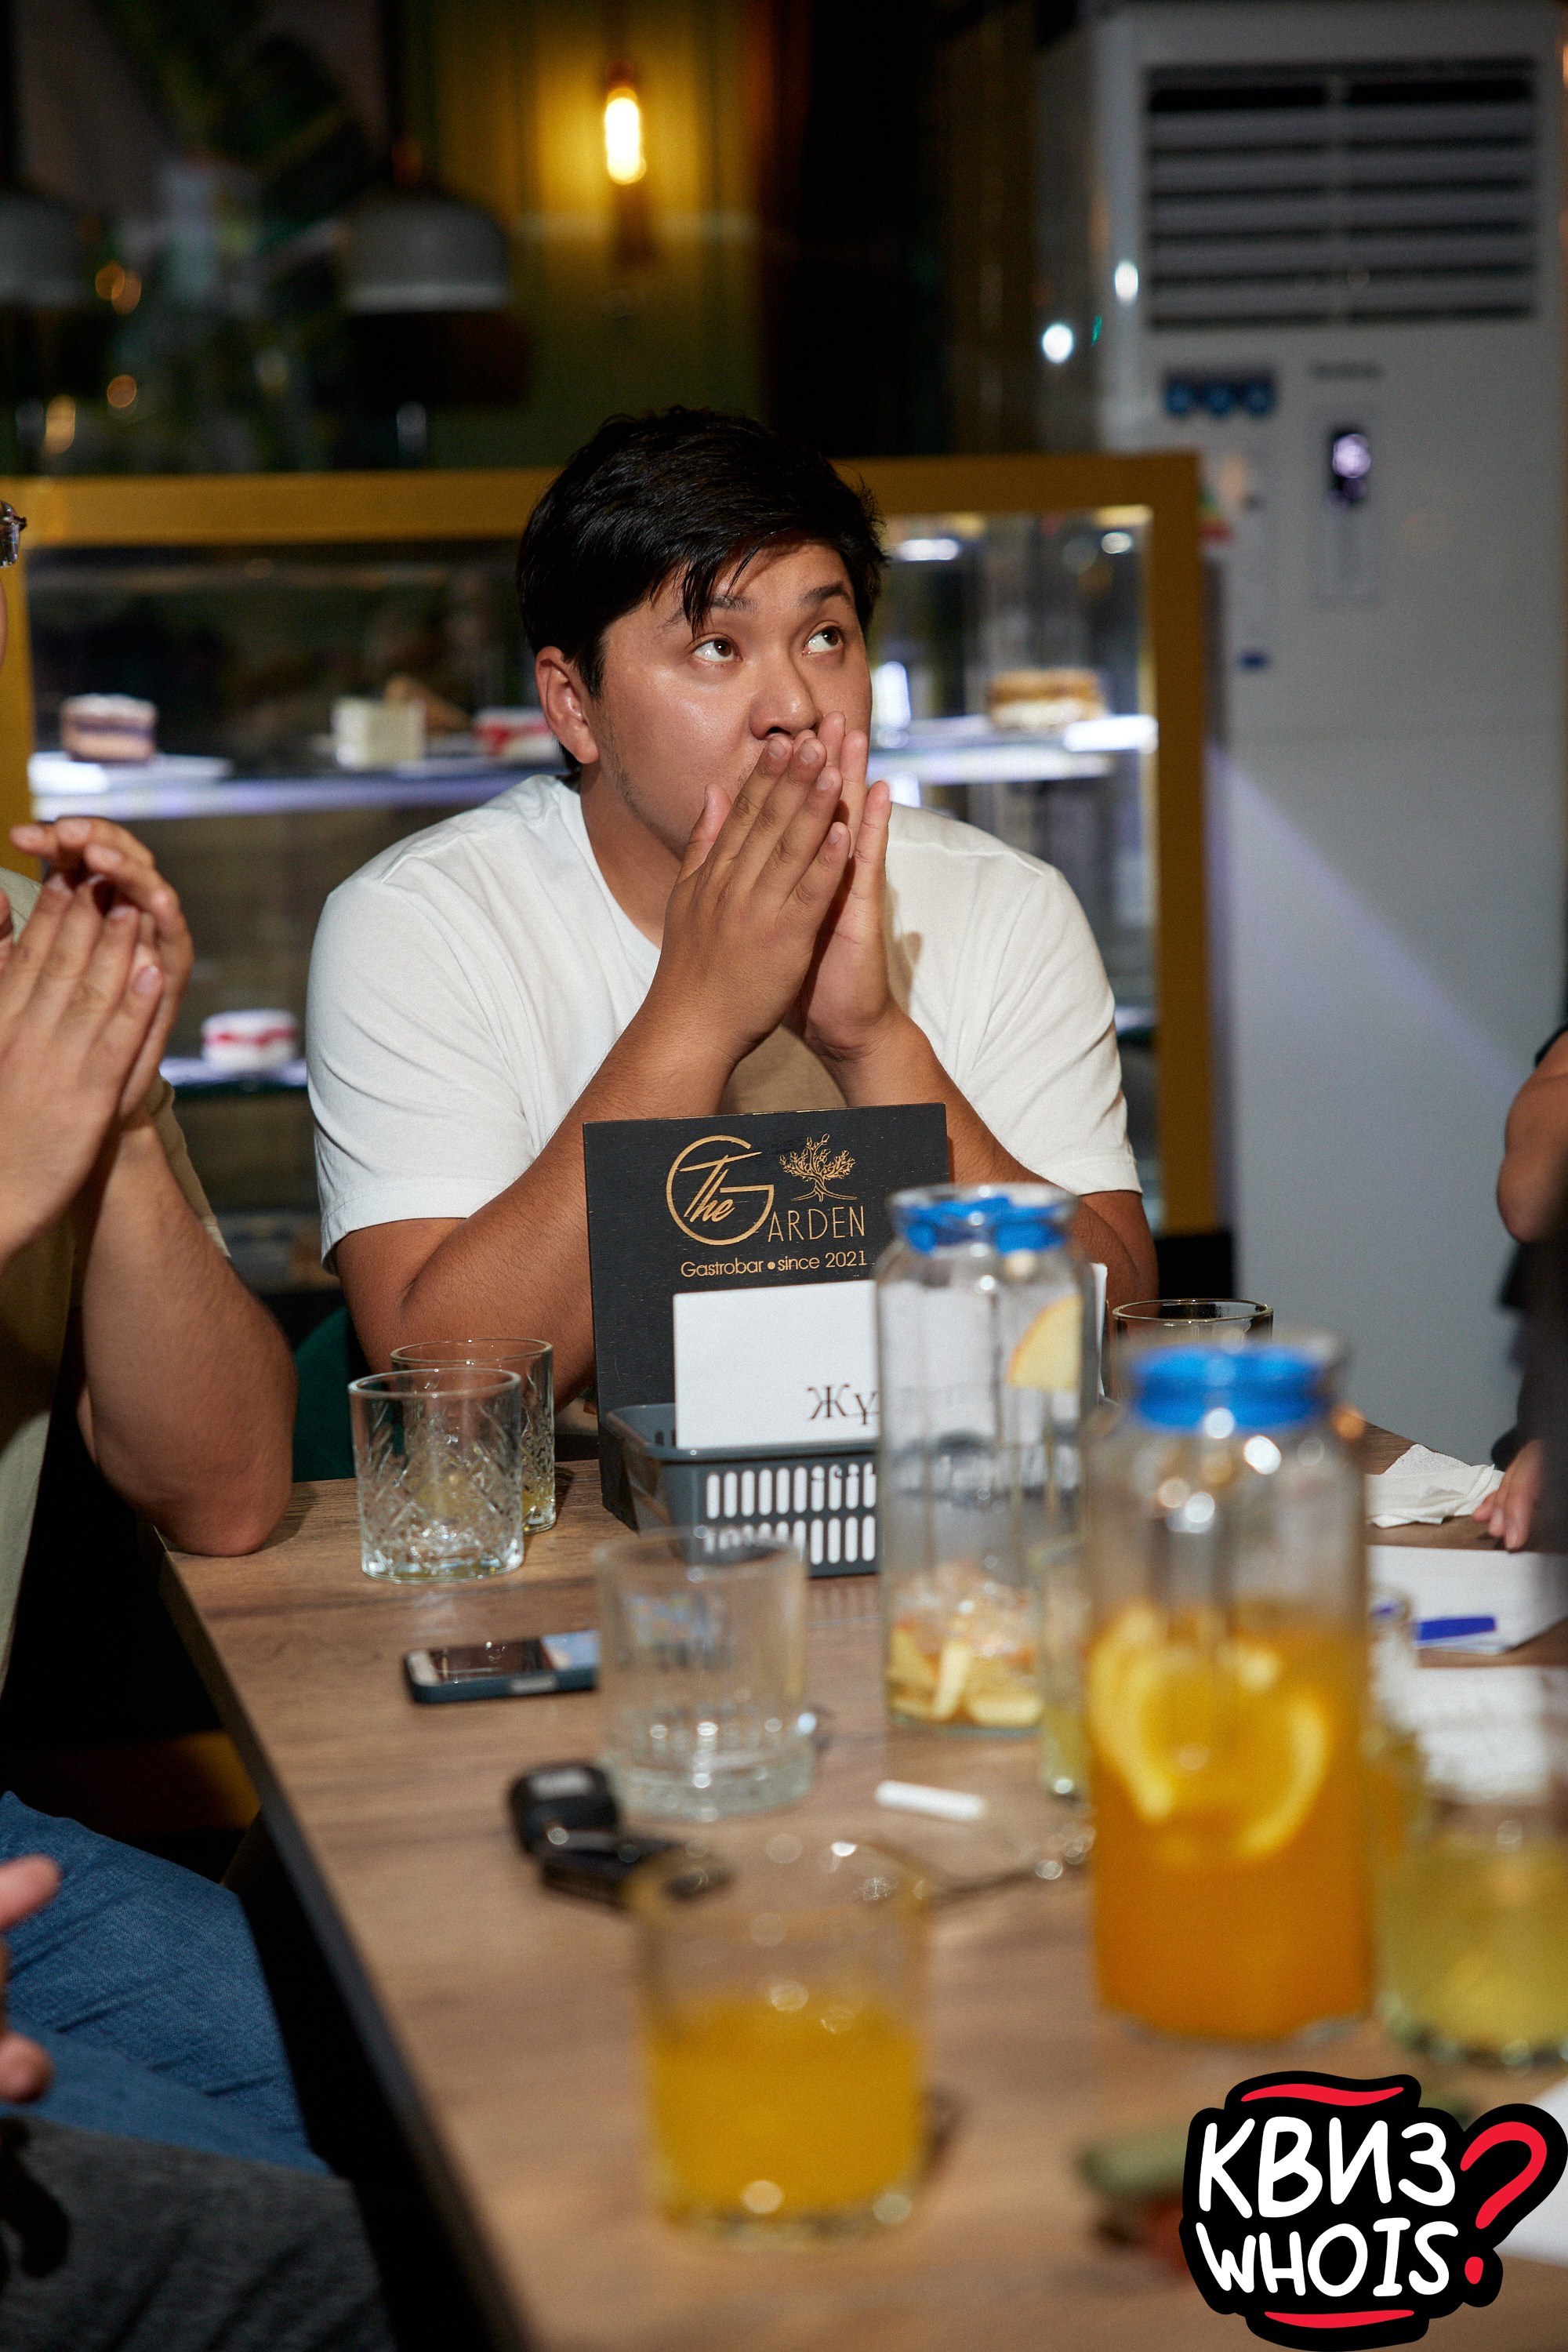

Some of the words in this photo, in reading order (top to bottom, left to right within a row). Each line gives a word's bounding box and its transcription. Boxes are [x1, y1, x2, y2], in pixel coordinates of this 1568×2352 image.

[680, 1152, 763, 1223] The
[681, 1258, 764, 1277] Gastrobar
[778, 1256, 820, 1272] since
[825, 1250, 867, 1268] 2021
